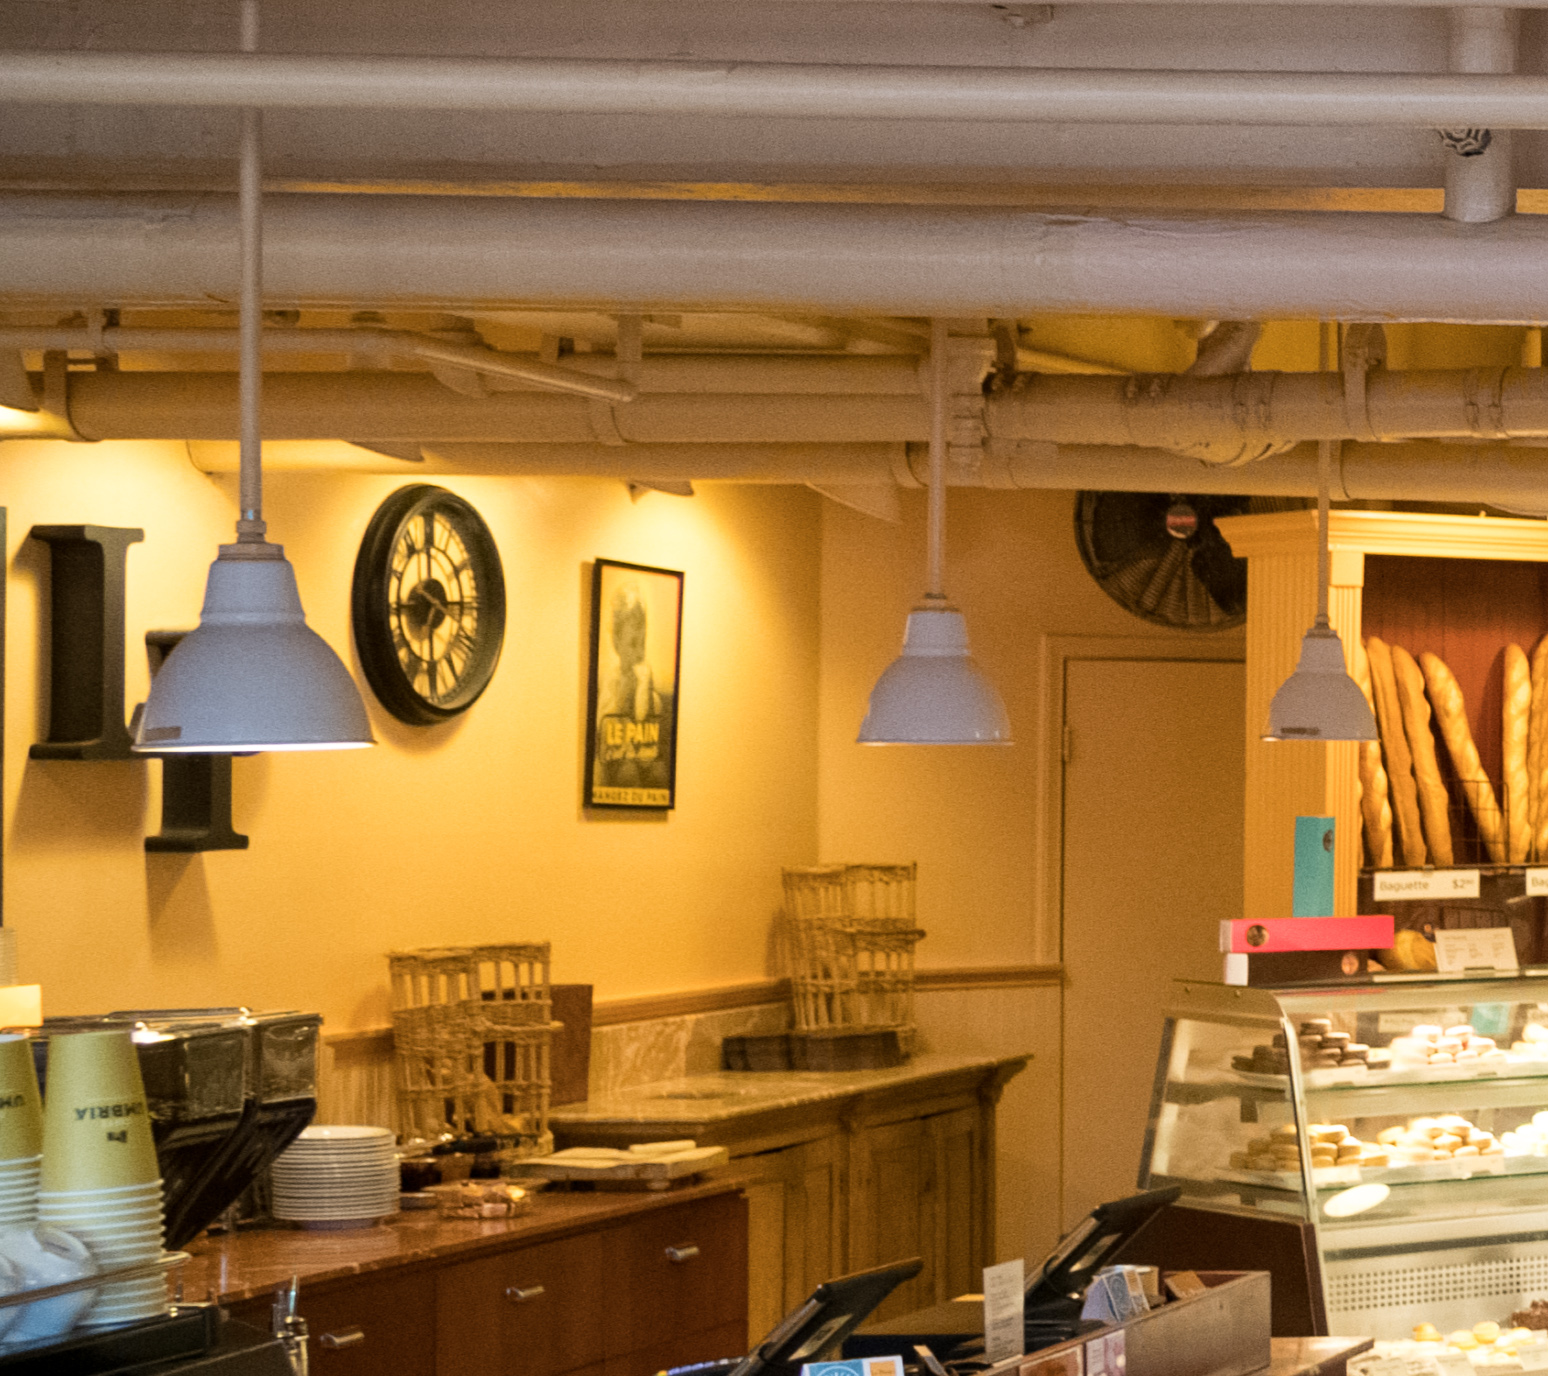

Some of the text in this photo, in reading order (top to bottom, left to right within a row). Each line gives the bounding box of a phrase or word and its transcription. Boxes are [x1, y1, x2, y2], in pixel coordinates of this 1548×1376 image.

[606, 722, 660, 745] LE PAIN
[1378, 880, 1430, 894] Baguette
